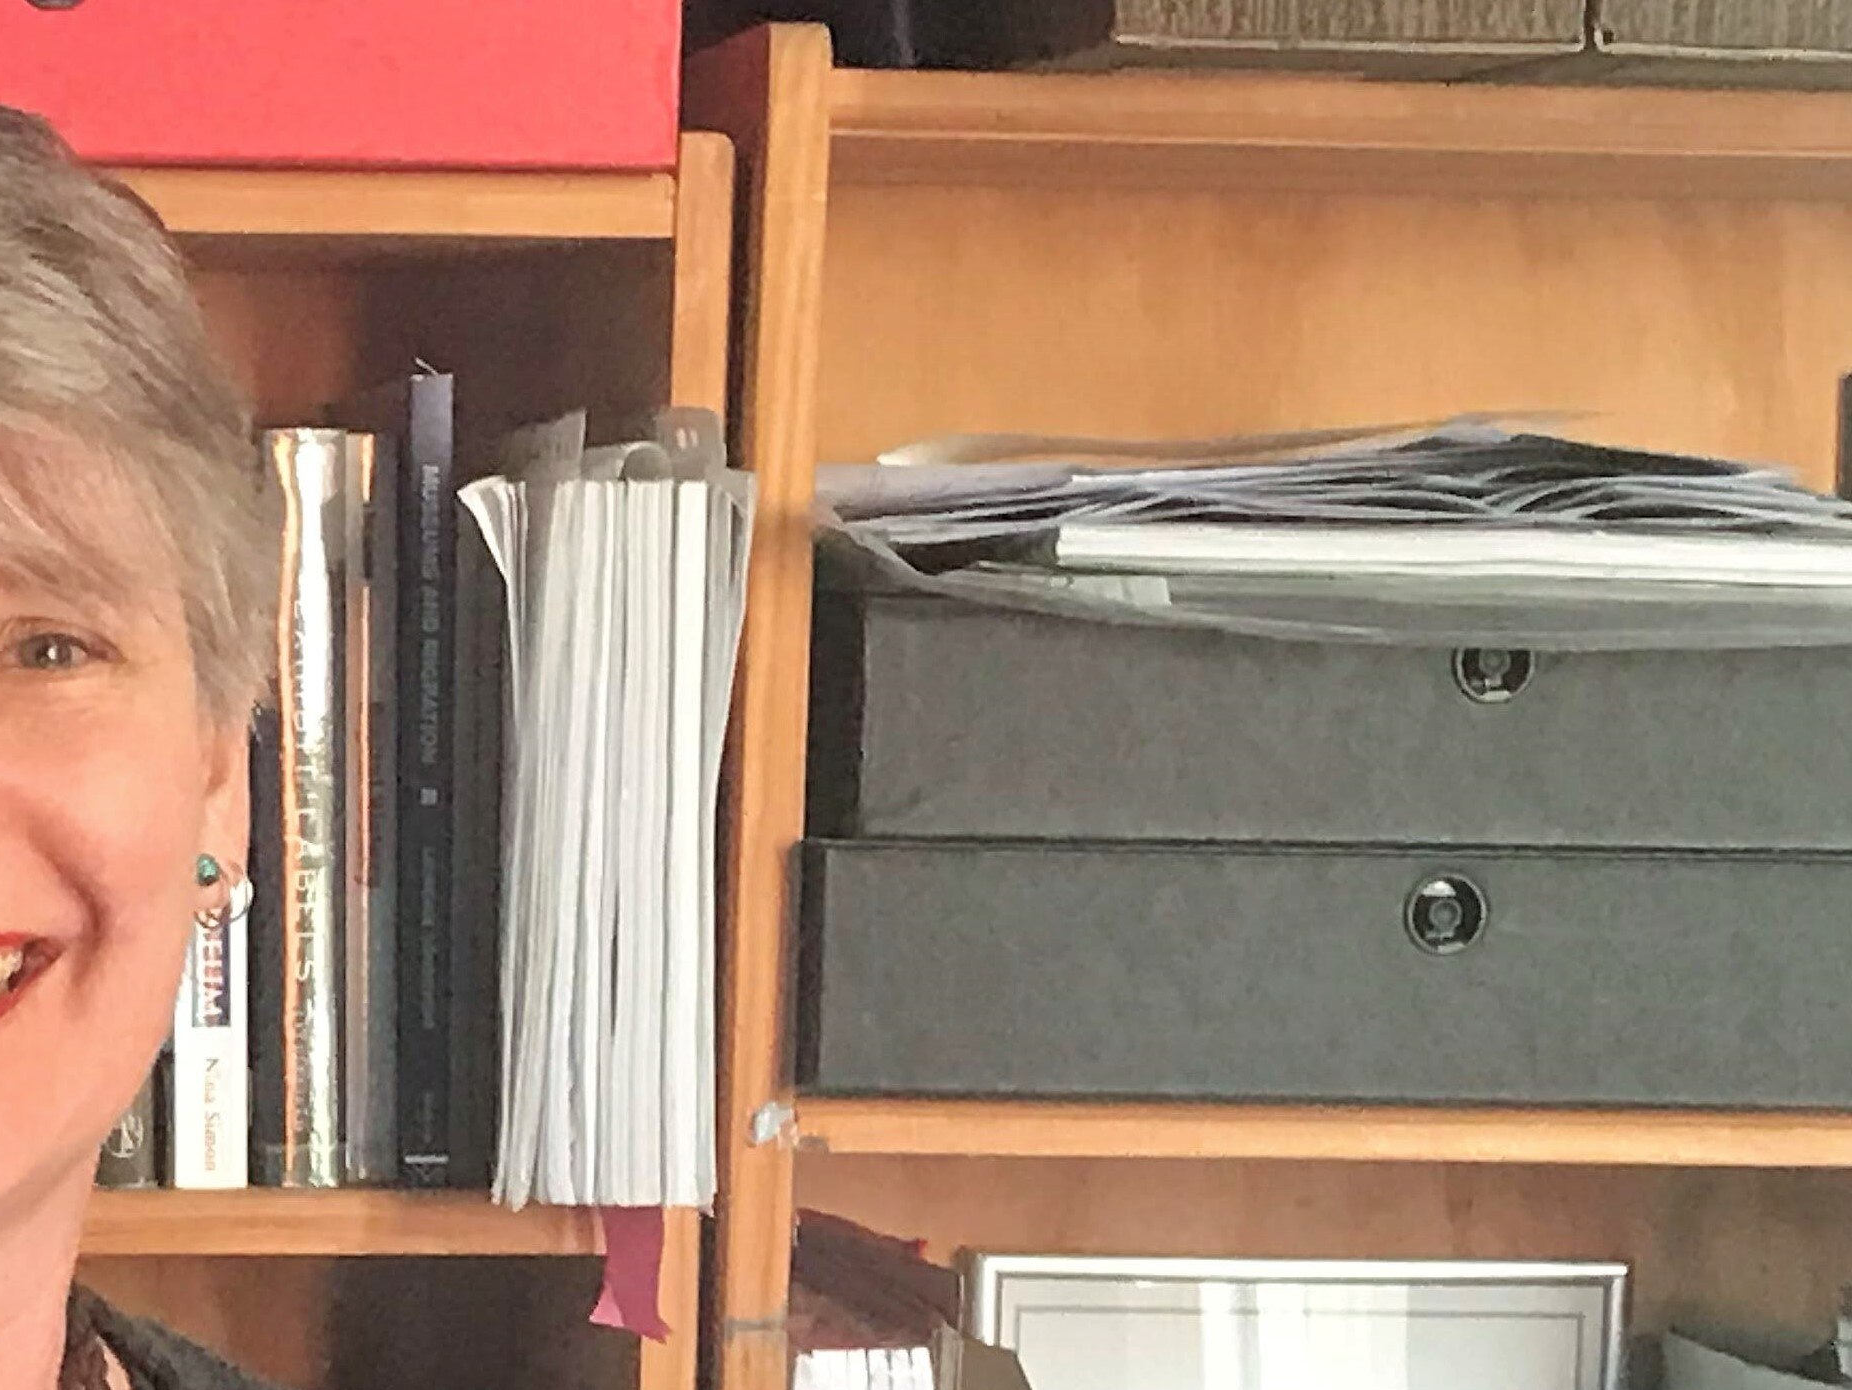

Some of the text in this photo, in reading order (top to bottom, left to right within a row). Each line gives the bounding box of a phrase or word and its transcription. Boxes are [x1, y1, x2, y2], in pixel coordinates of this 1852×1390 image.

[420, 464, 440, 579] MUSEUMS
[421, 585, 440, 633] AND
[203, 1057, 220, 1172] Nina Simon
